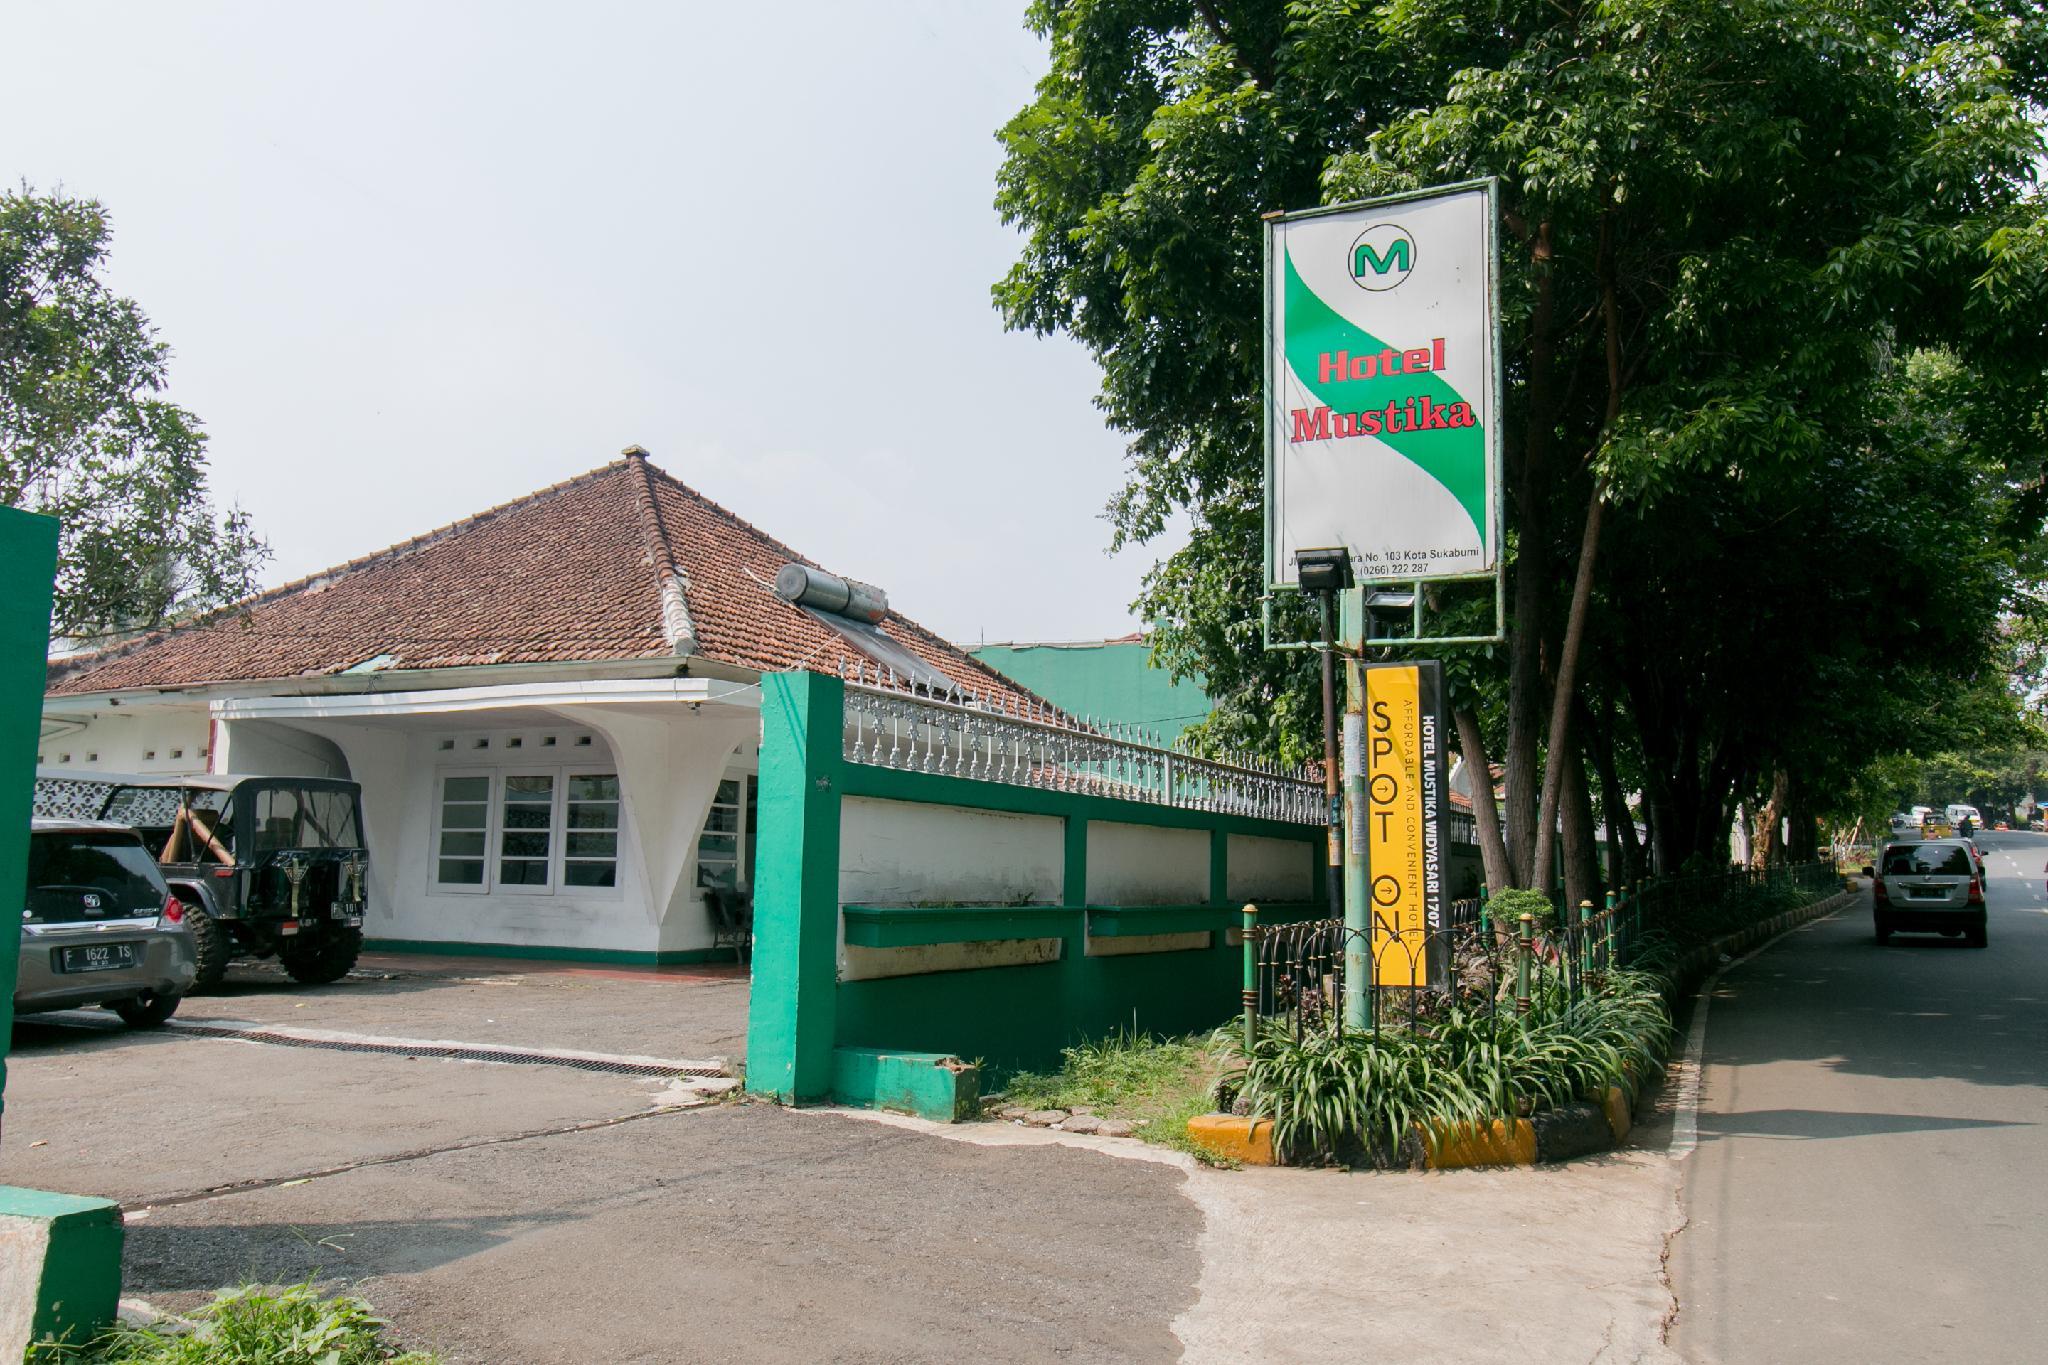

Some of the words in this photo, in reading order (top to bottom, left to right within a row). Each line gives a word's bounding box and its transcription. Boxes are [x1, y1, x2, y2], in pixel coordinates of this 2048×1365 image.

[1355, 238, 1410, 277] M
[1318, 338, 1446, 384] Hotel
[1290, 395, 1476, 443] Mustika
[1360, 565, 1389, 576] (0266)
[1392, 564, 1409, 574] 222
[1411, 563, 1428, 573] 287
[1365, 552, 1381, 561] No.
[1384, 551, 1401, 560] 103
[1404, 550, 1427, 560] Kota
[1430, 546, 1479, 559] Sukabumi
[1403, 700, 1415, 780] AFFORDABLE
[1422, 715, 1436, 758] HOTEL
[1406, 785, 1415, 811] AND
[1424, 760, 1438, 819] MUSTIKA
[1406, 816, 1418, 898] CONVENIENT
[1425, 821, 1440, 893] WIDYASARI
[1408, 904, 1419, 945] HOTEL
[1427, 896, 1441, 929] 1707
[66, 950, 73, 962] F
[85, 947, 110, 960] 1622
[118, 945, 131, 958] TS
